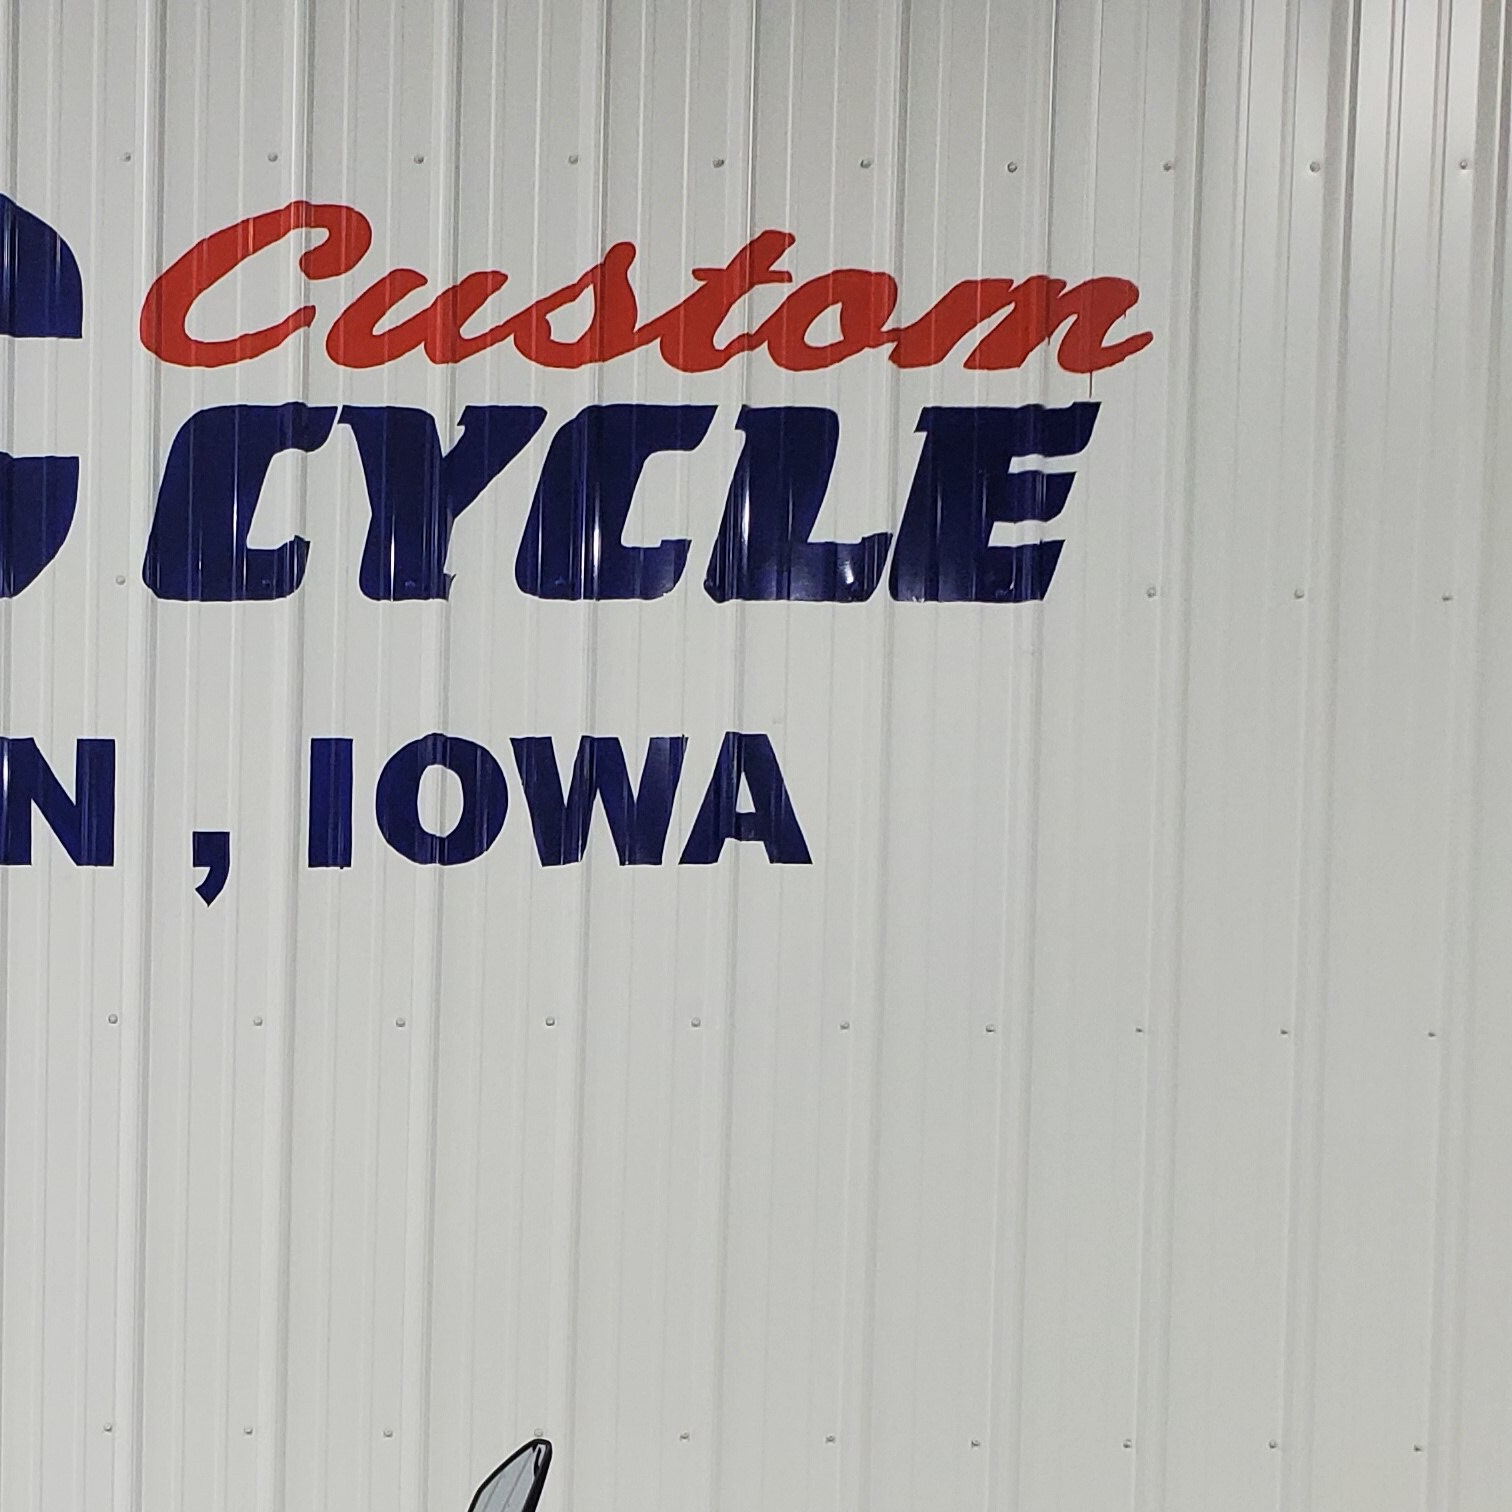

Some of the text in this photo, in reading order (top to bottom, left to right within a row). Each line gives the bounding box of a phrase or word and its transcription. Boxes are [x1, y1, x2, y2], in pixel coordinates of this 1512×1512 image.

[140, 201, 1153, 373] Custom
[142, 402, 1101, 603] CYCLE
[308, 732, 813, 870] IOWA
